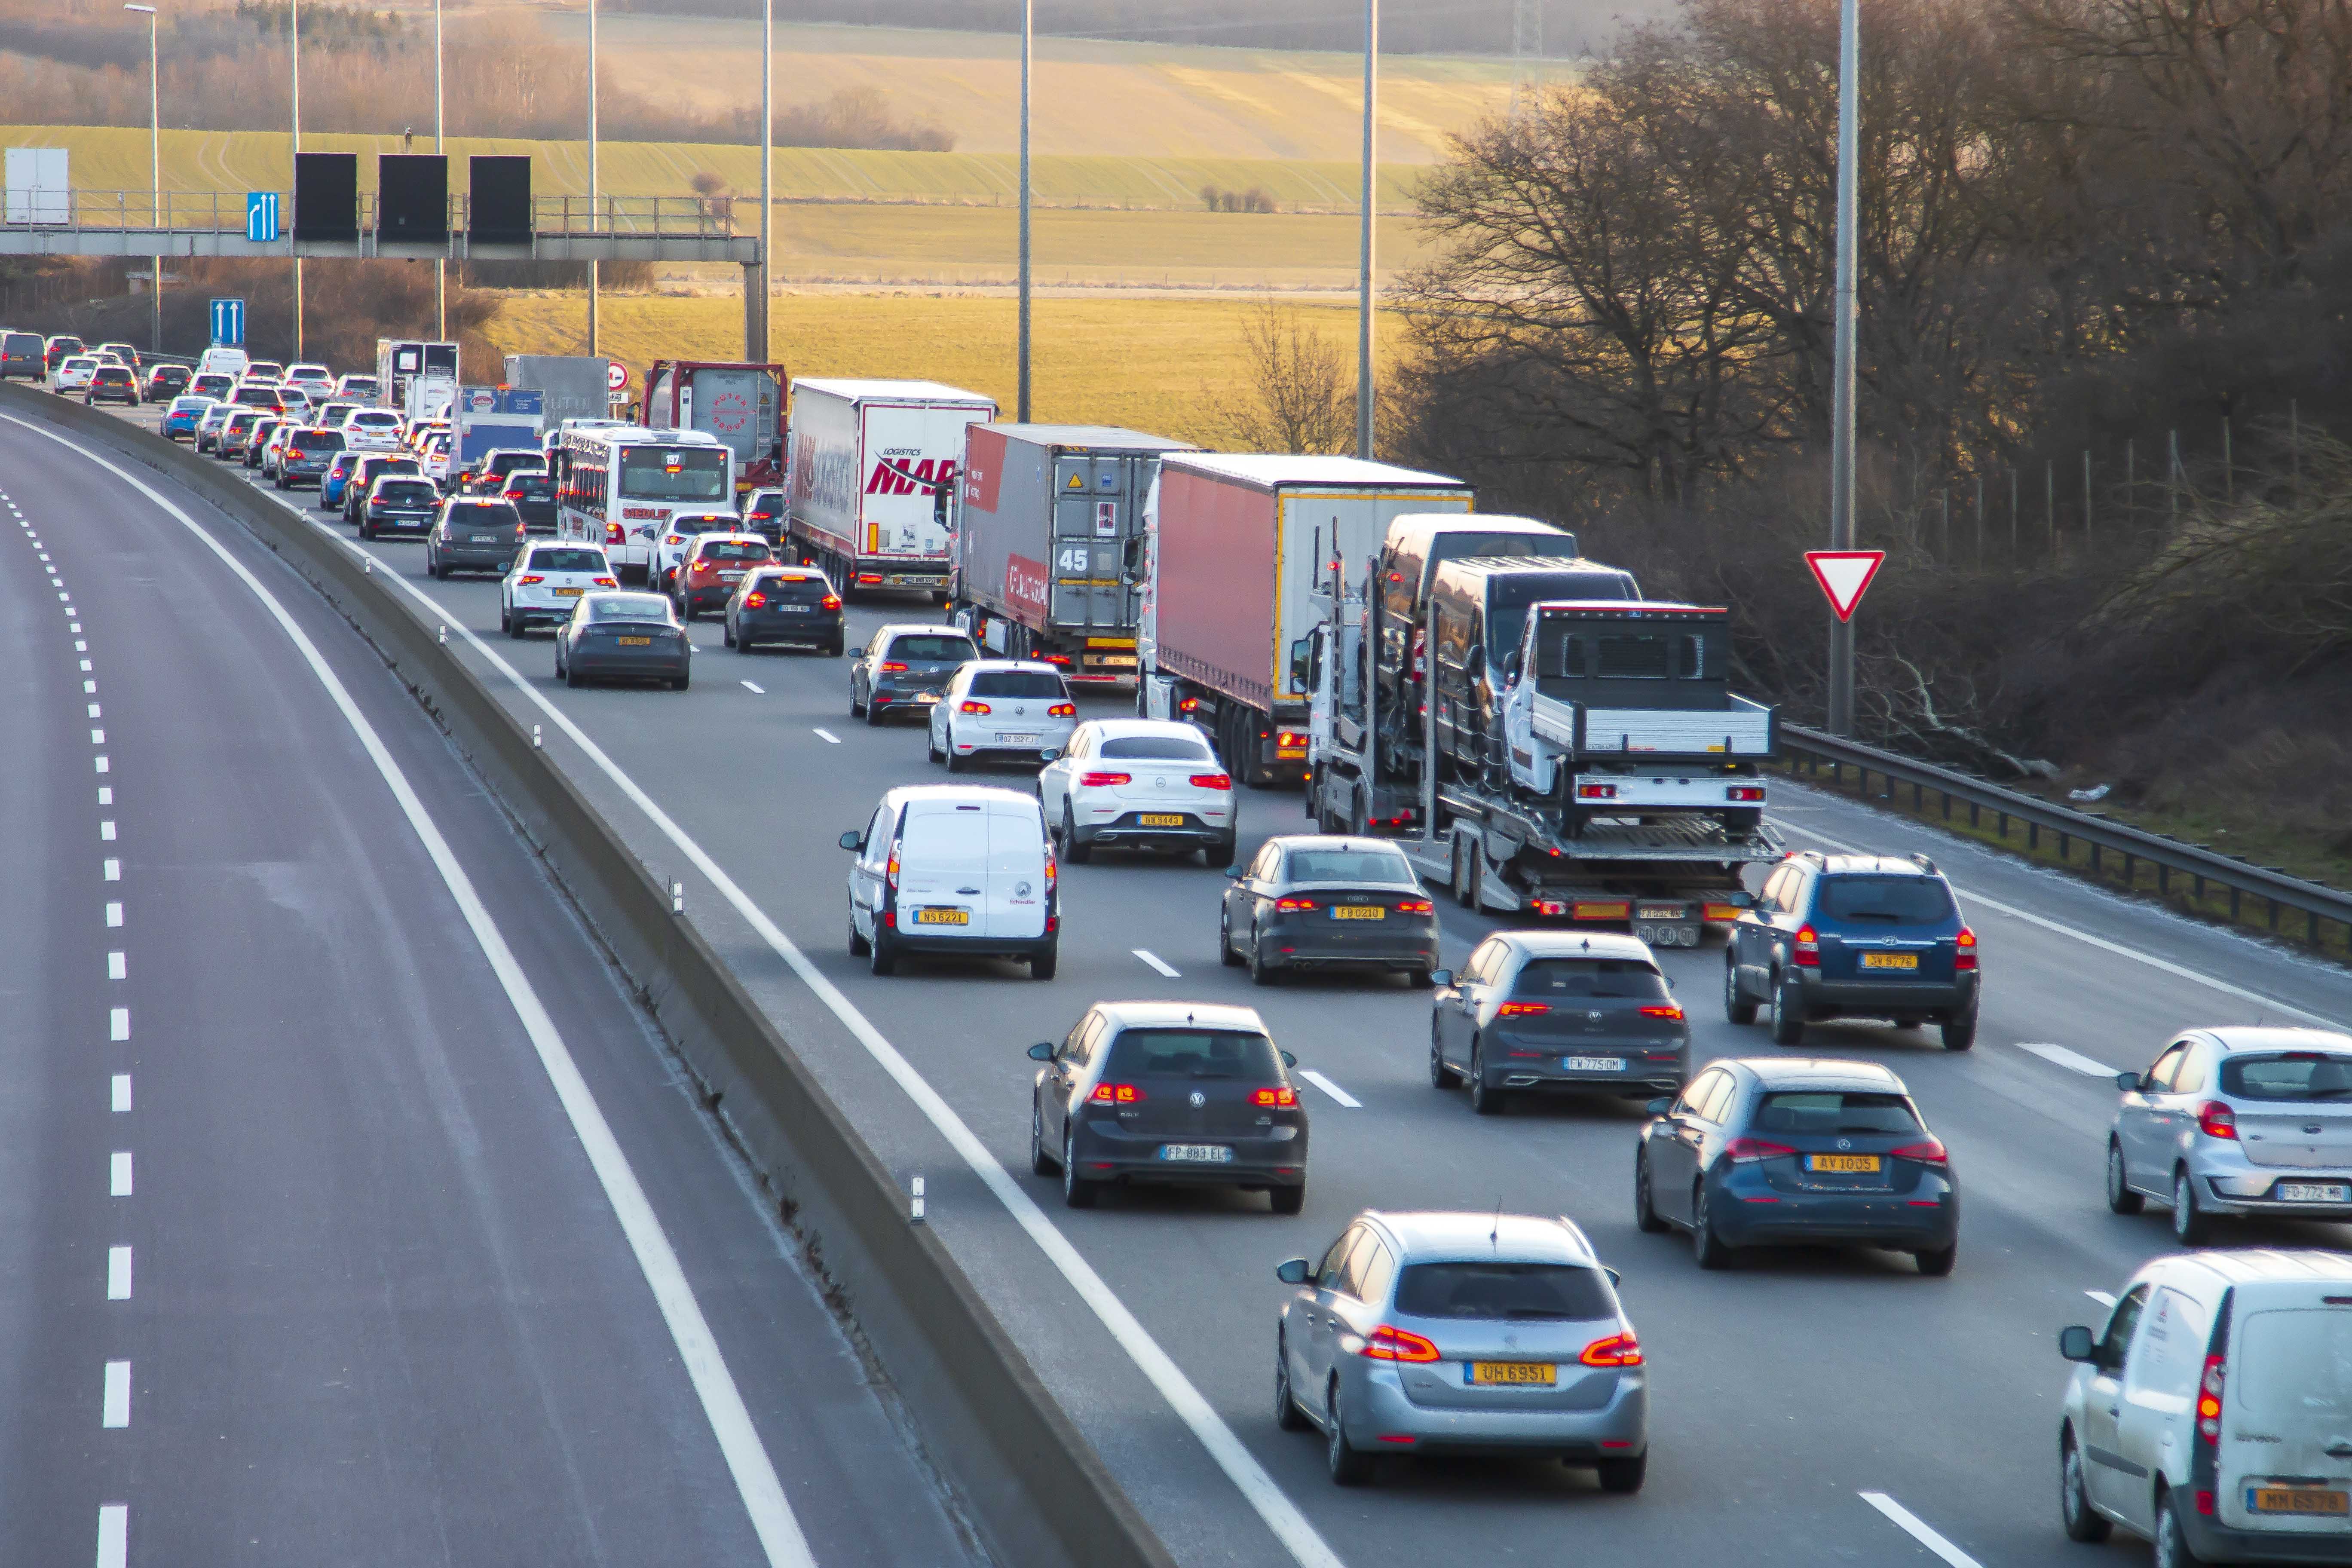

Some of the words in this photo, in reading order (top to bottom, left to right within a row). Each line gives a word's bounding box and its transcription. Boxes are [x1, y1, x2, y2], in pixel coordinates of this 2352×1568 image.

[883, 448, 922, 456] LOGISTICS
[666, 454, 680, 465] 197
[1059, 549, 1087, 571] 45
[924, 913, 936, 922] NS
[939, 913, 961, 922] 6221
[1341, 908, 1353, 917] FB
[1356, 908, 1378, 918] 0210
[1821, 1158, 1837, 1169] AV
[1840, 1158, 1871, 1170] 1005
[1484, 1366, 1504, 1380] UH
[1507, 1366, 1546, 1381] 6951
[2266, 1494, 2288, 1508] MM
